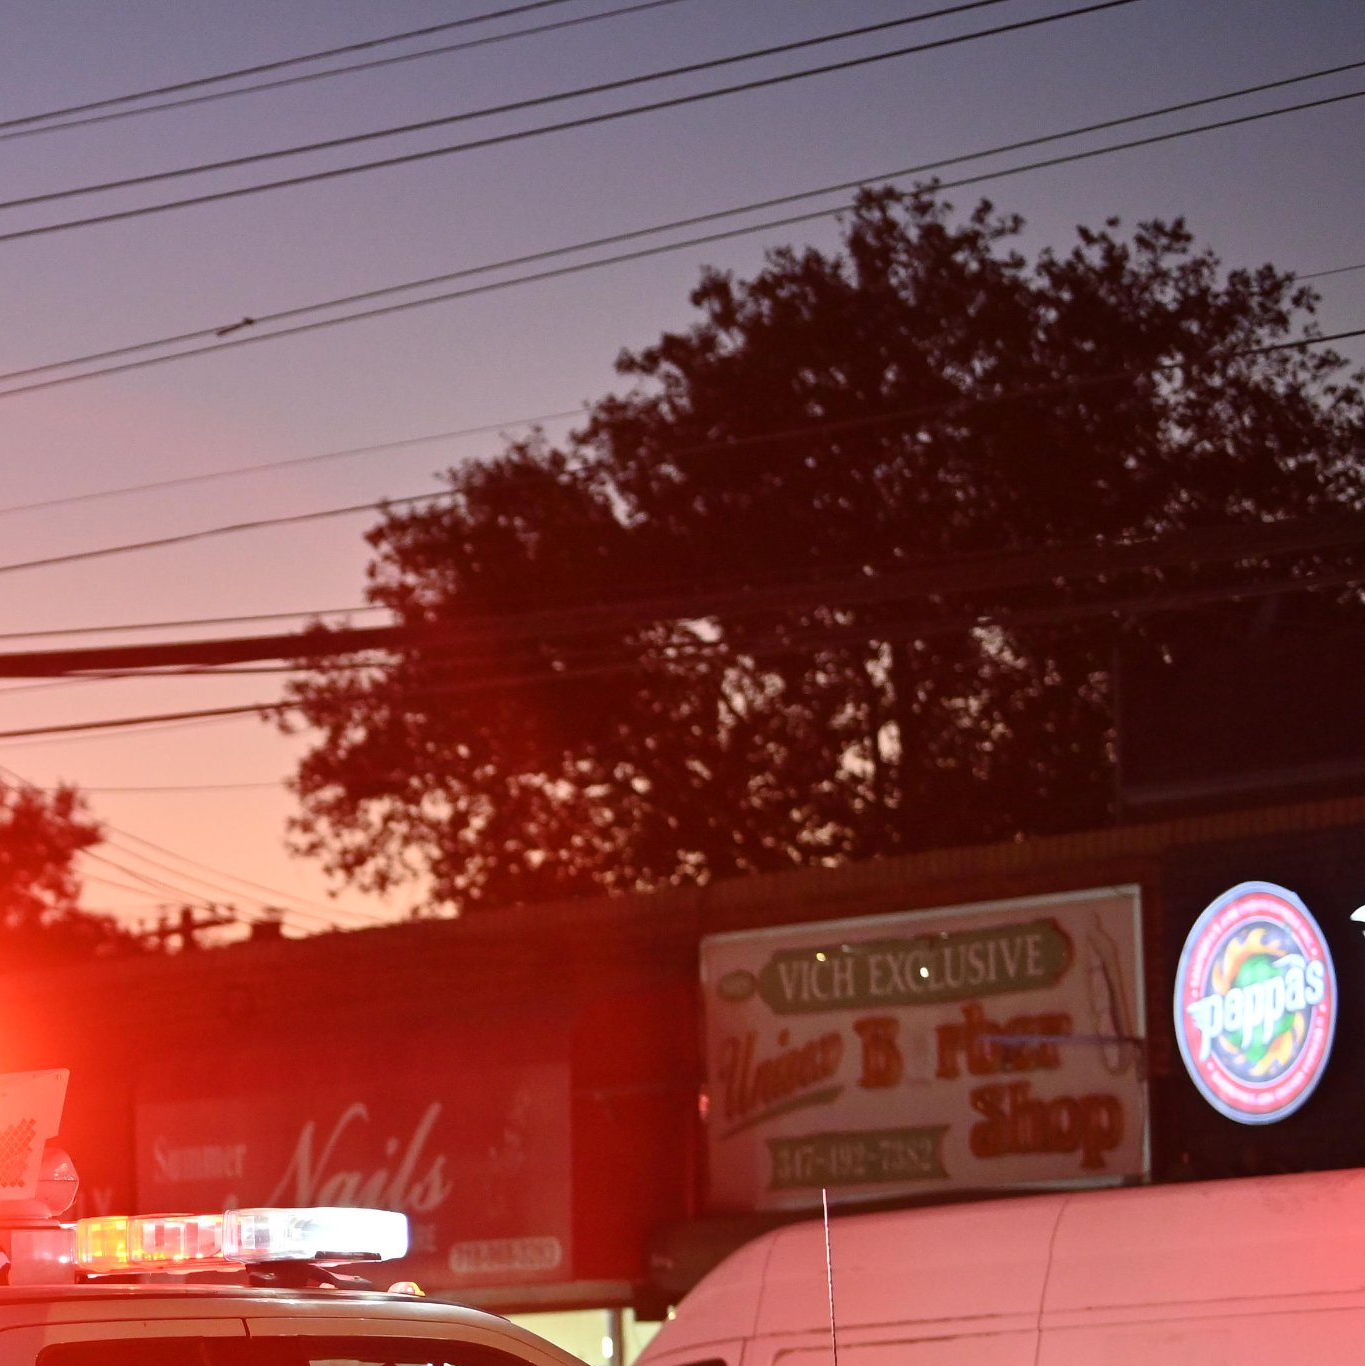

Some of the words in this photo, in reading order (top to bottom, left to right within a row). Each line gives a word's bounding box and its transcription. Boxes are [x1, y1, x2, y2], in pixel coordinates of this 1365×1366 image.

[777, 957, 856, 1004] VICH
[868, 932, 1045, 995] EXCLUSIVE
[265, 1101, 454, 1211] Nails
[969, 1081, 1126, 1170] Shop
